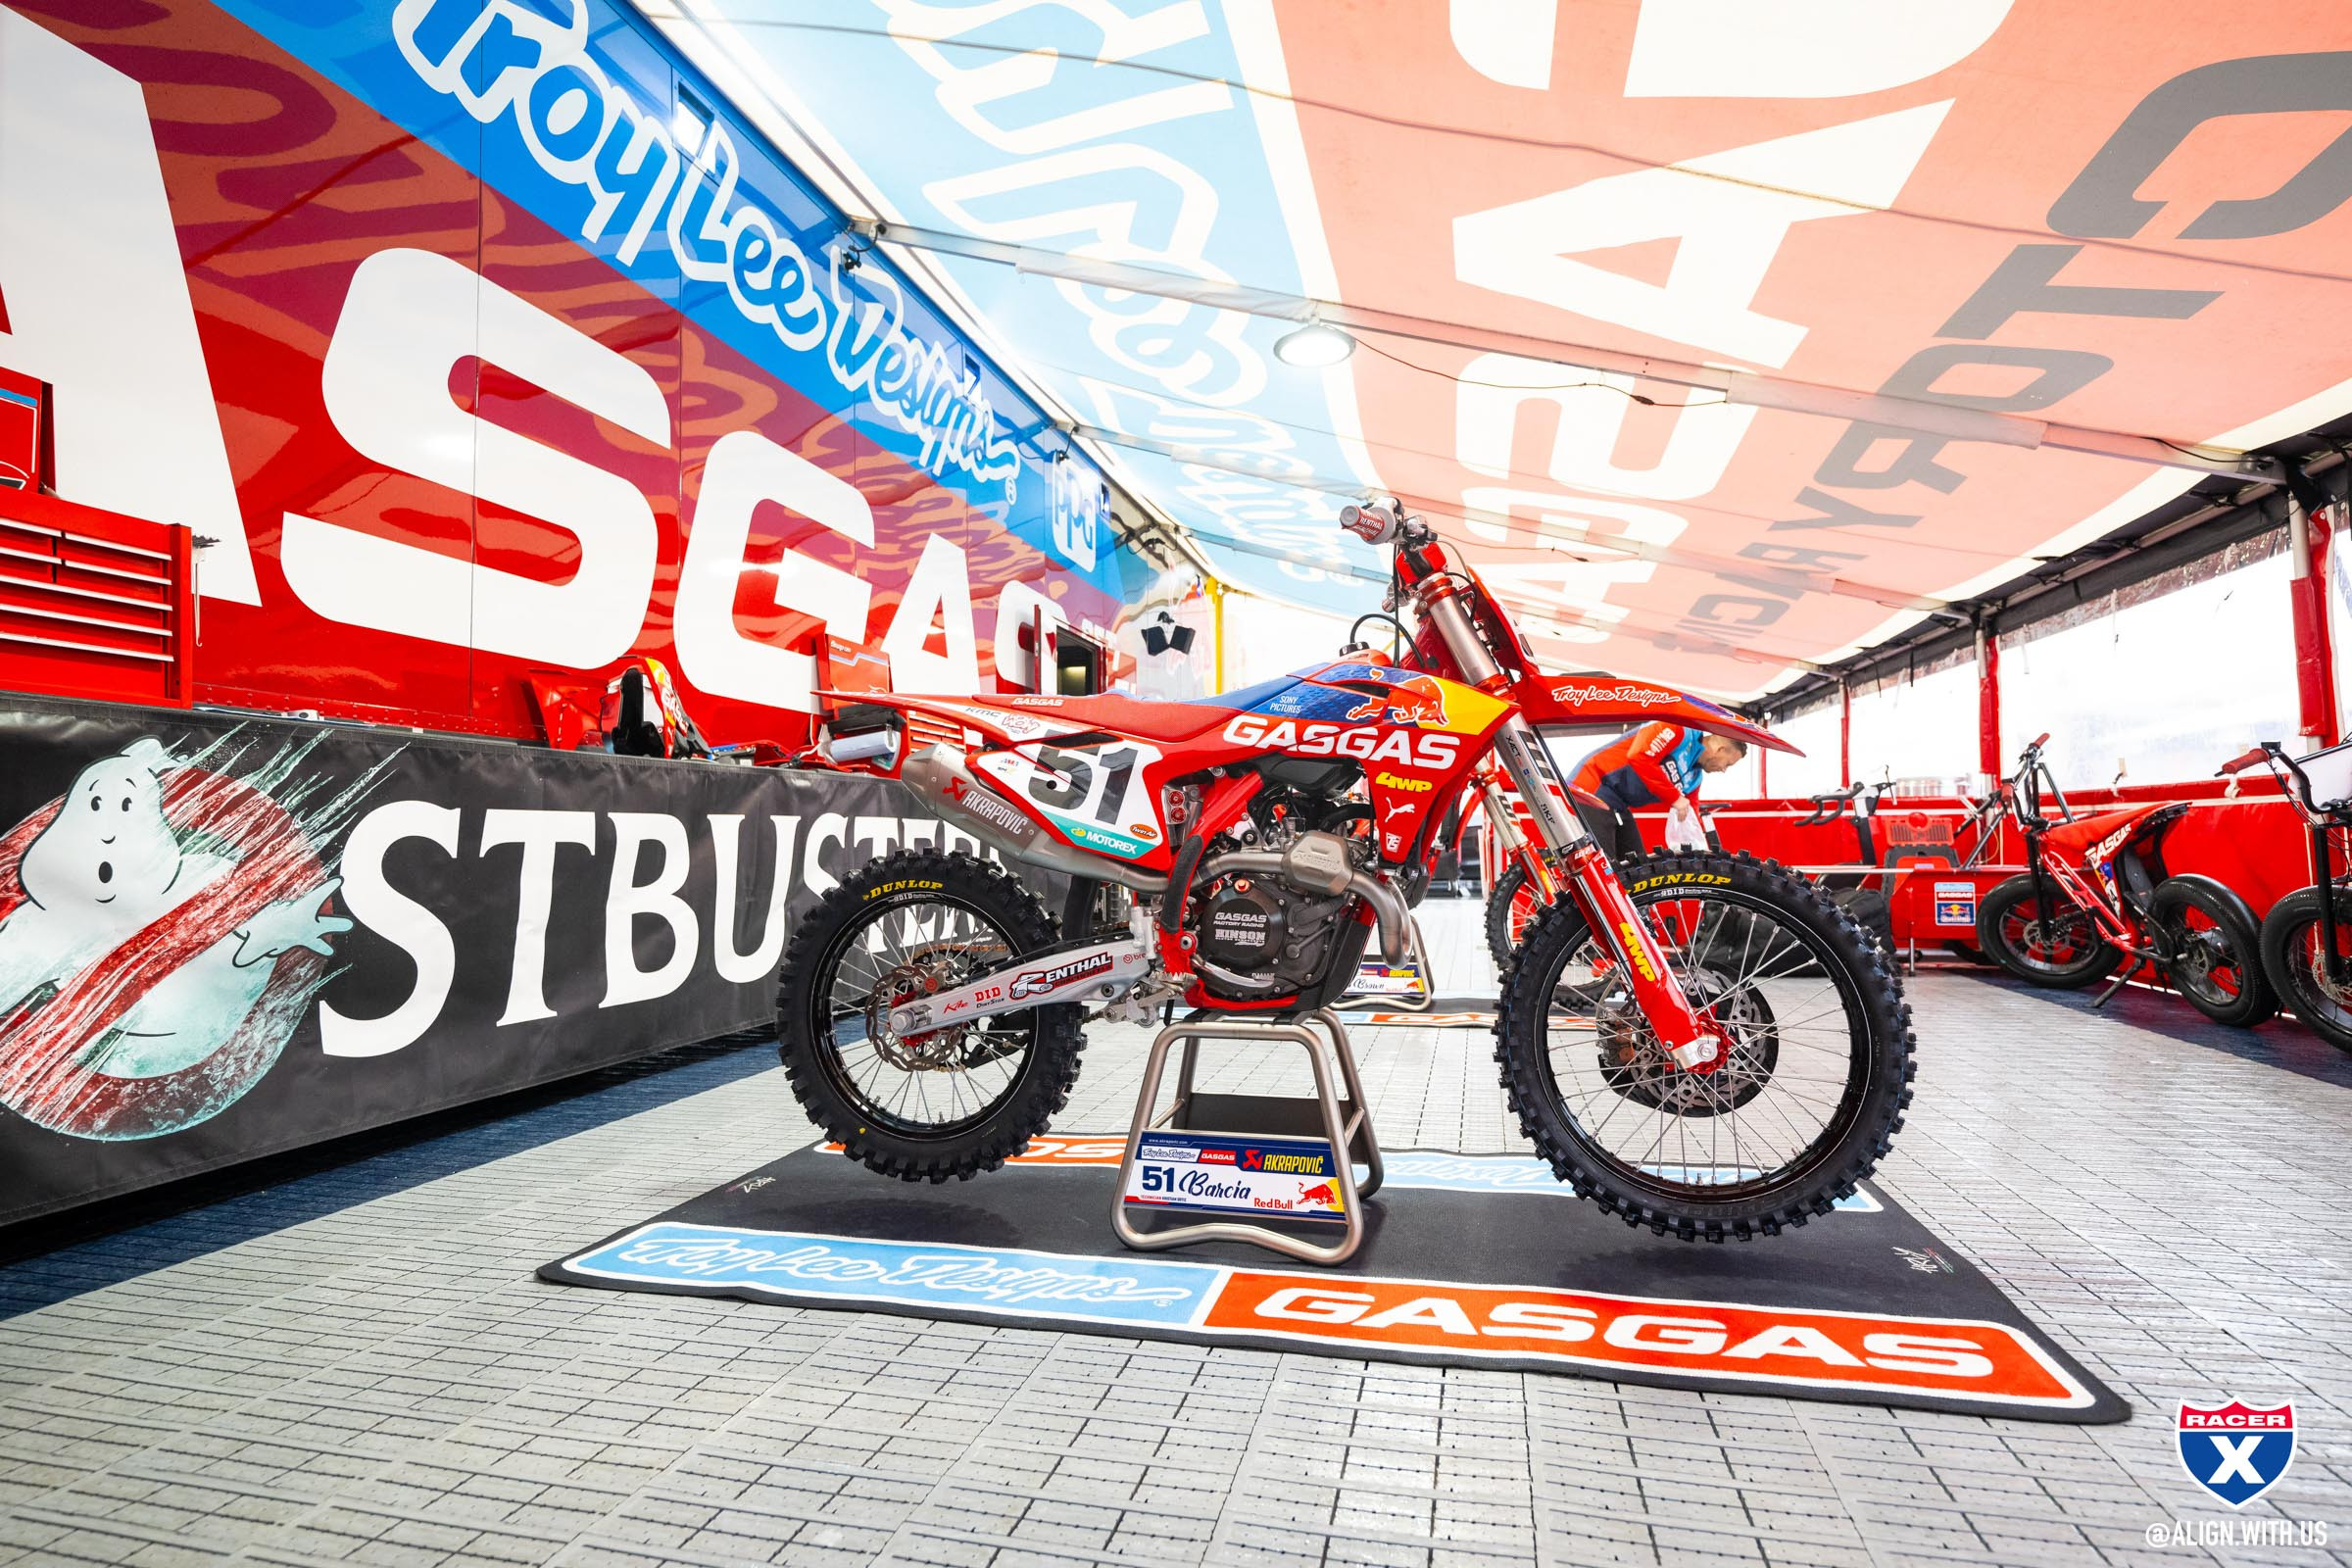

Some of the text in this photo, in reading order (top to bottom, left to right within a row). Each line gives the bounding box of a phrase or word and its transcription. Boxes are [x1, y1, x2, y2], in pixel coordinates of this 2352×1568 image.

[392, 0, 678, 267] Troy
[669, 127, 826, 352] Lee
[826, 245, 1021, 483] Designs
[1011, 697, 1064, 707] GASGAS
[1279, 695, 1298, 705] SONY
[1551, 685, 1682, 708] Troy Lee Designs
[1269, 702, 1301, 714] PICTURES
[1223, 714, 1460, 770] GASGAS
[1028, 728, 1139, 826] 51
[1375, 771, 1433, 793] 4WP
[961, 790, 1029, 835] AKRAPOVIČ
[1540, 803, 1556, 825] SKF
[1086, 830, 1138, 856] MOTOREX
[869, 879, 944, 900] DUNLOP
[1634, 872, 1732, 893] DUNLOP
[1214, 911, 1268, 924] GASGAS
[1215, 928, 1266, 941] HINSON
[1619, 921, 1656, 982] 4WP
[974, 986, 1001, 1003] DID
[1143, 1148, 1157, 1158] Troy
[1200, 1152, 1236, 1161] GASGAS
[1263, 1154, 1324, 1174] AKRAPOVIČ
[1142, 1165, 1251, 1200] 51 Barcia
[1253, 1197, 1293, 1210] Red Bull
[618, 1237, 1193, 1302] Troy Lee Designs
[1253, 1287, 1994, 1377] GASGAS
